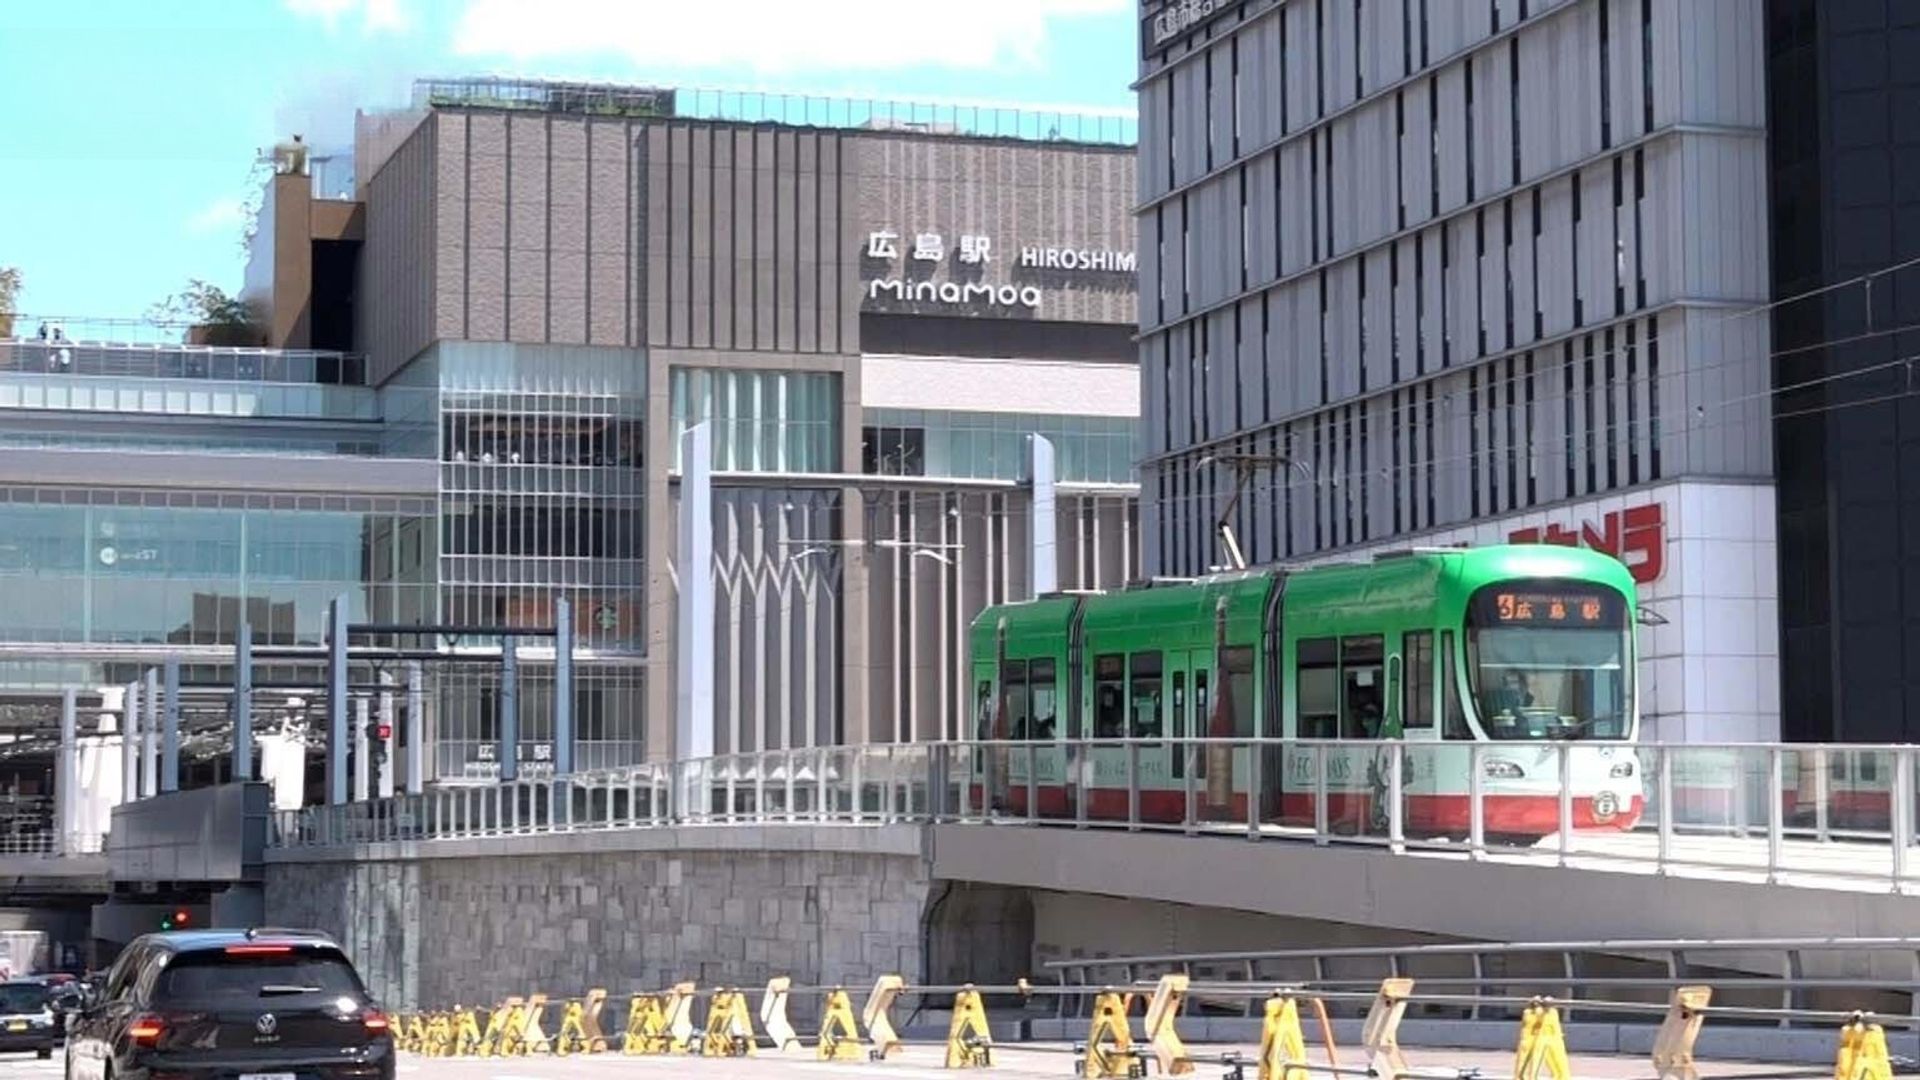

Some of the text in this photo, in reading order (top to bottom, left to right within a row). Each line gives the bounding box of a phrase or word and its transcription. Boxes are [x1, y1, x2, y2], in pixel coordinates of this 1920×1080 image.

[867, 230, 1138, 272] 広島駅 HIROSHIM
[478, 745, 551, 760] 広駅
